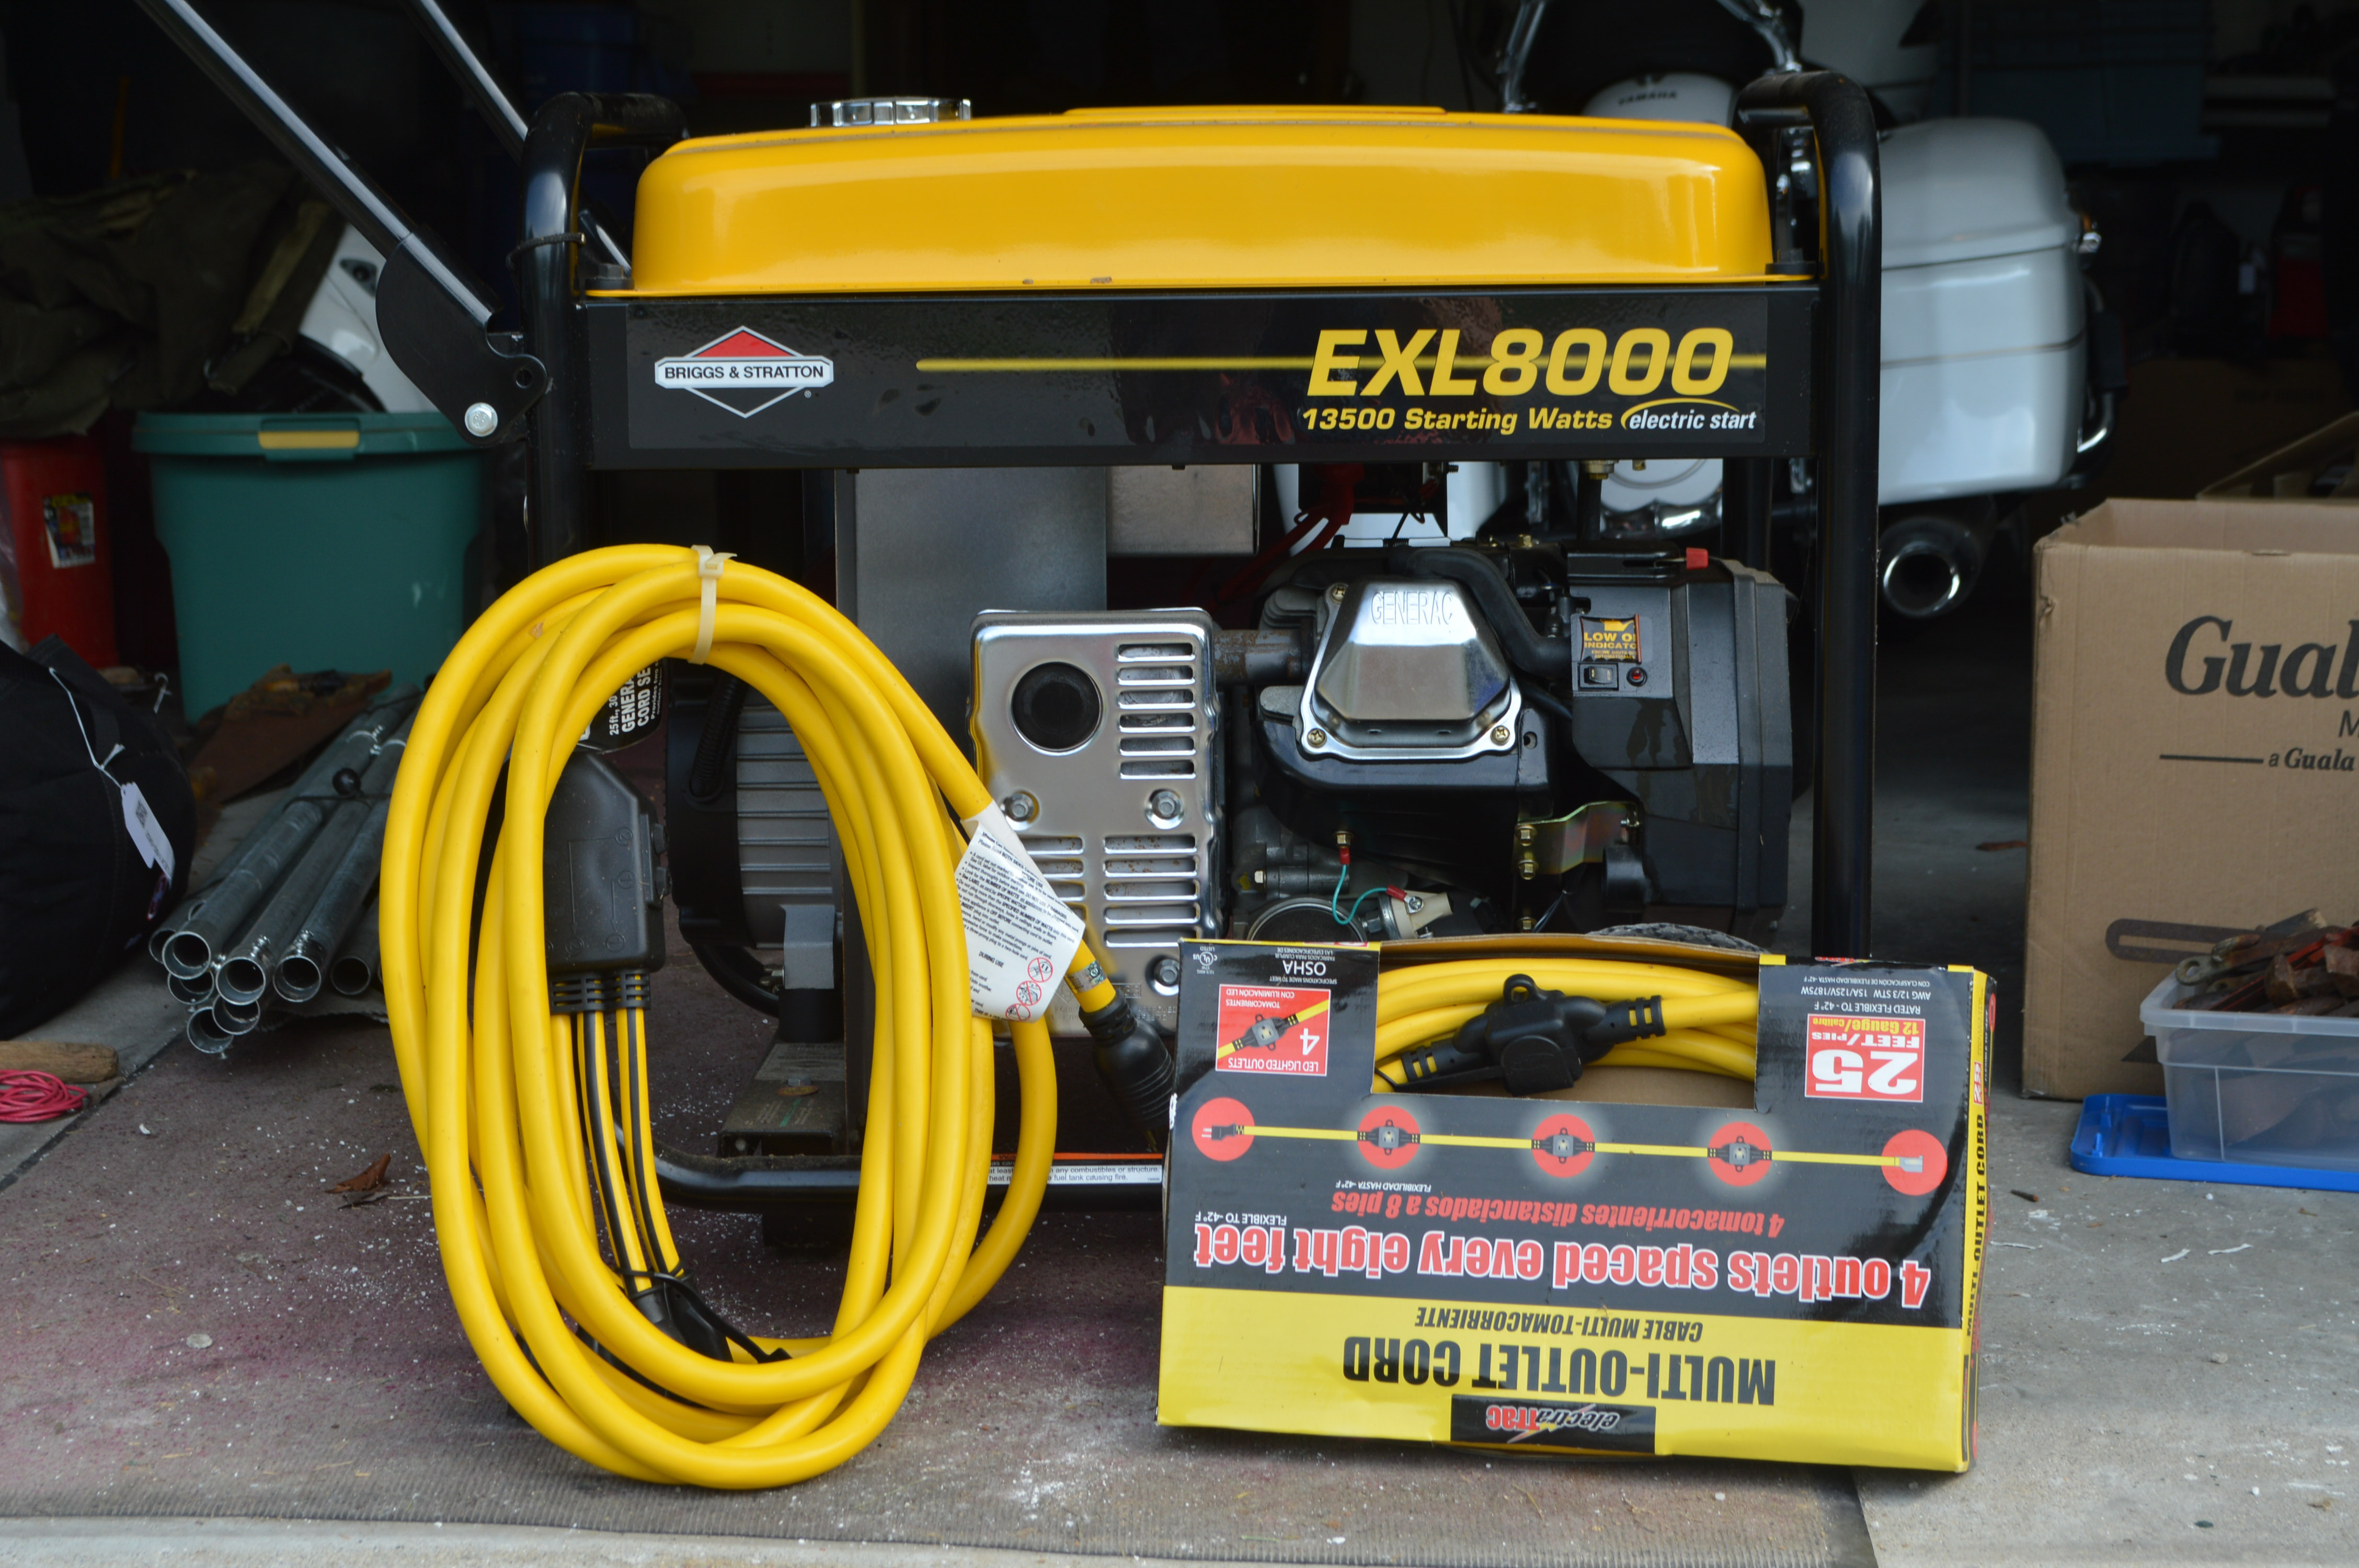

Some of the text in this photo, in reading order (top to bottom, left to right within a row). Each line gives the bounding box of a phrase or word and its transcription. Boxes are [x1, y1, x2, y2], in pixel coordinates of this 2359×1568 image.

[1307, 327, 1733, 397] EXL8000
[665, 365, 823, 379] BRIGGS & STRATTON
[1302, 407, 1613, 435] 13500 Starting Watts
[1629, 409, 1757, 430] electric start
[1371, 591, 1453, 625] GENERAC
[1584, 632, 1636, 643] LOW OI
[609, 695, 618, 708] 30
[620, 676, 636, 733] GENERA
[637, 667, 651, 727] CORD SE
[2269, 747, 2355, 771] a Guala
[1001, 902, 1020, 914] SPECIFIED
[1019, 910, 1035, 921] NUMBER
[1040, 921, 1053, 931] WATTS
[978, 950, 1004, 968] DURING USE
[1281, 959, 1326, 976] OSHA
[1239, 988, 1279, 998] ILUMINACIÓN
[1800, 985, 1931, 1000] AWG 12/3 STW 15A/125V/1875W
[1225, 998, 1280, 1008] TOMACORRIENTES
[1813, 1000, 1818, 1010] F
[1840, 1001, 1852, 1011] TO
[1854, 1001, 1891, 1013] FLEXIBLE
[1893, 1004, 1920, 1014] RATED
[1902, 1021, 1919, 1034] 12
[1299, 1027, 1320, 1055] 4
[1227, 1056, 1318, 1071] LED LIGHTED OUTLETS
[1811, 1048, 1918, 1094] 25
[1335, 1179, 1341, 1188] F
[1357, 1180, 1381, 1190] HASTA
[1382, 1182, 1431, 1193] FLEXIBILIDAD
[1194, 1210, 1201, 1221] F
[1224, 1212, 1239, 1224] TO
[1241, 1213, 1286, 1226] FLEXIBLE
[1330, 1190, 1784, 1238] 4 tomacorrientes distanciados a 8 pies
[1193, 1222, 1930, 1308] 4 outlets spaced every eight feet
[1414, 1307, 1703, 1342] CABLE MULTI-TOMACORRIENTE
[1342, 1336, 1775, 1405] MULTI-OUTLET CORD
